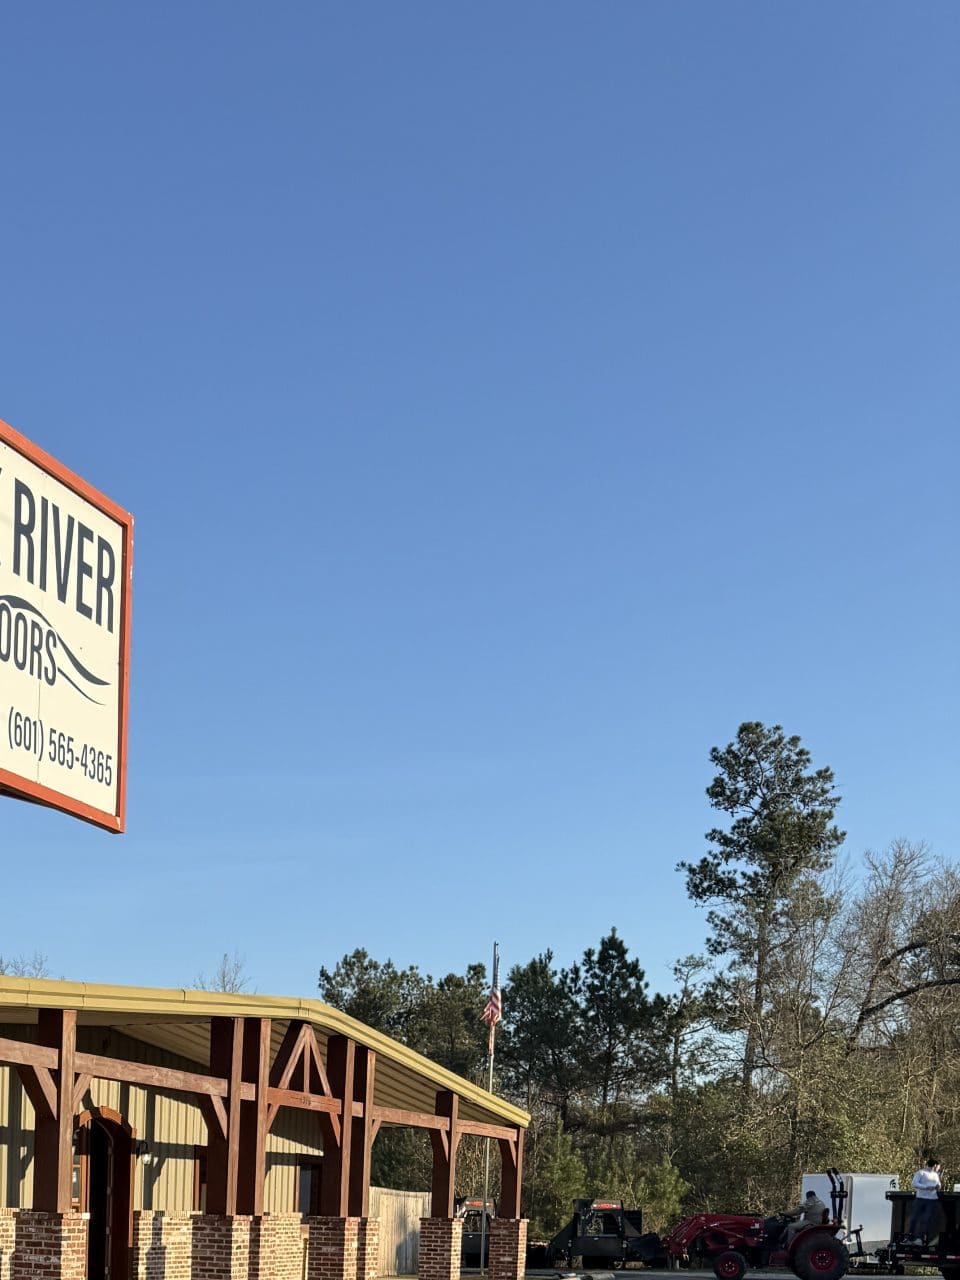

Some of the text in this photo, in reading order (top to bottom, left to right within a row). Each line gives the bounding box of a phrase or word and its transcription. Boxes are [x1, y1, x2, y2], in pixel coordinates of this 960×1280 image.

[12, 477, 116, 634] RIVER
[7, 706, 44, 762] (601)
[48, 728, 113, 788] 565-4365
